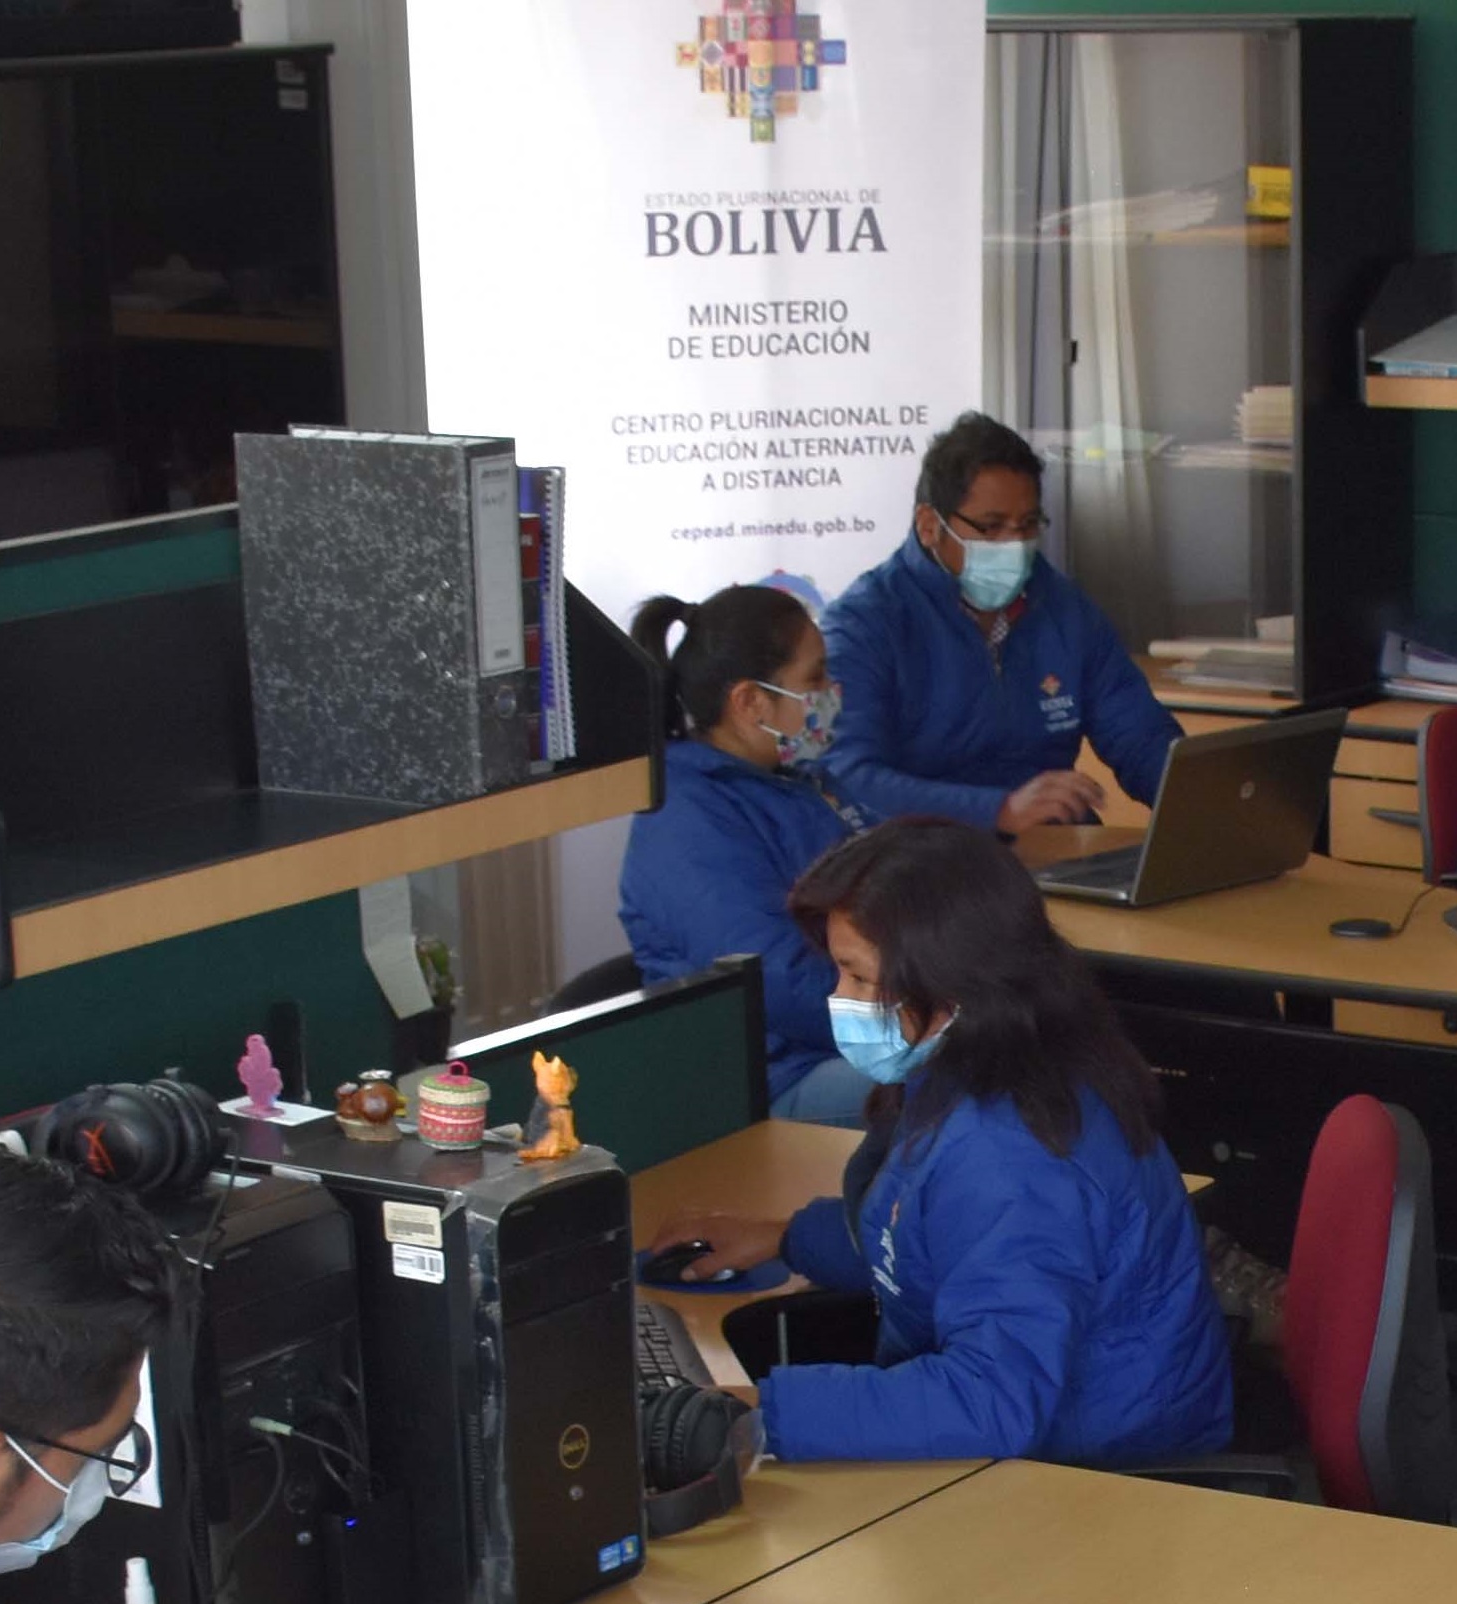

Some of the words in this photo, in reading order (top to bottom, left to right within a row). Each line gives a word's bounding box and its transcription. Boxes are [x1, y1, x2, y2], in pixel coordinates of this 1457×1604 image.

[645, 192, 711, 208] ESTADO
[716, 189, 851, 207] PLURINACIONAL
[859, 189, 881, 204] DE
[644, 206, 888, 257] BOLIVIA
[688, 299, 849, 327] MINISTERIO
[668, 336, 703, 360] DE
[711, 326, 871, 358] EDUCACIÓN
[611, 412, 703, 436] CENTRO
[710, 407, 892, 431] PLURINACIONAL
[899, 405, 929, 426] DE
[626, 438, 758, 465] EDUCACIÓN
[764, 435, 916, 459] ALTERNATIVA
[702, 473, 717, 492] A
[723, 468, 843, 491] DISTANCIA
